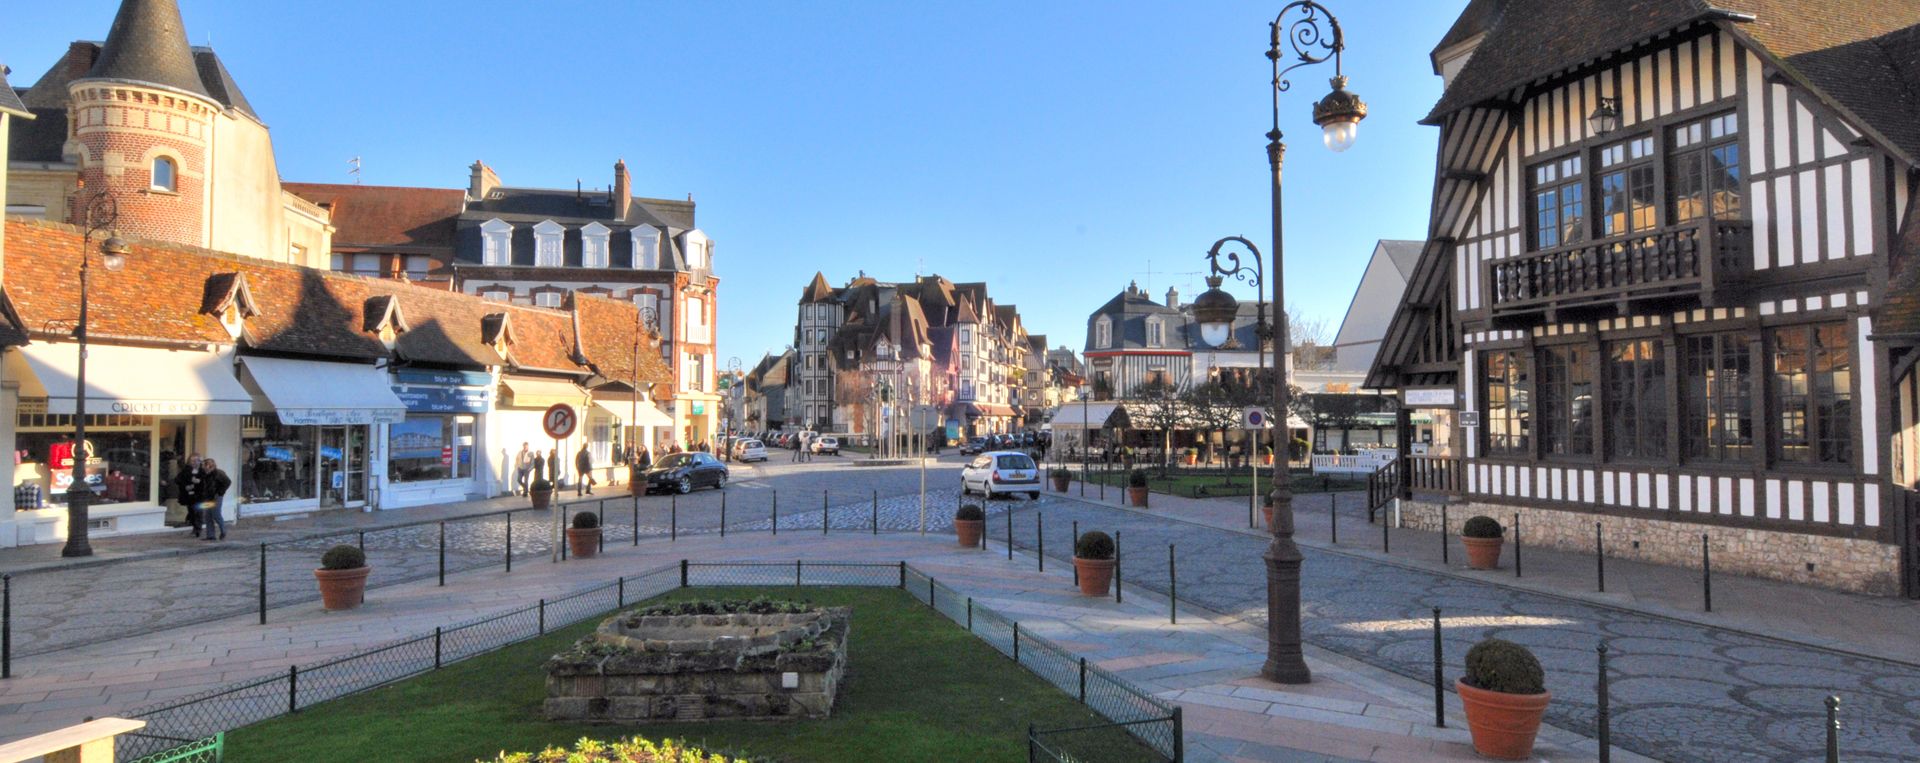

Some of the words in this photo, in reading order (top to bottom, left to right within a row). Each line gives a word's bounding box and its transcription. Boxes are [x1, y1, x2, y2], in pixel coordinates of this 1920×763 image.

[434, 375, 448, 383] blue
[449, 376, 462, 384] bay
[112, 402, 162, 413] CRICKET
[168, 402, 178, 413] &
[293, 416, 318, 424] Homme
[55, 472, 102, 486] Soes
